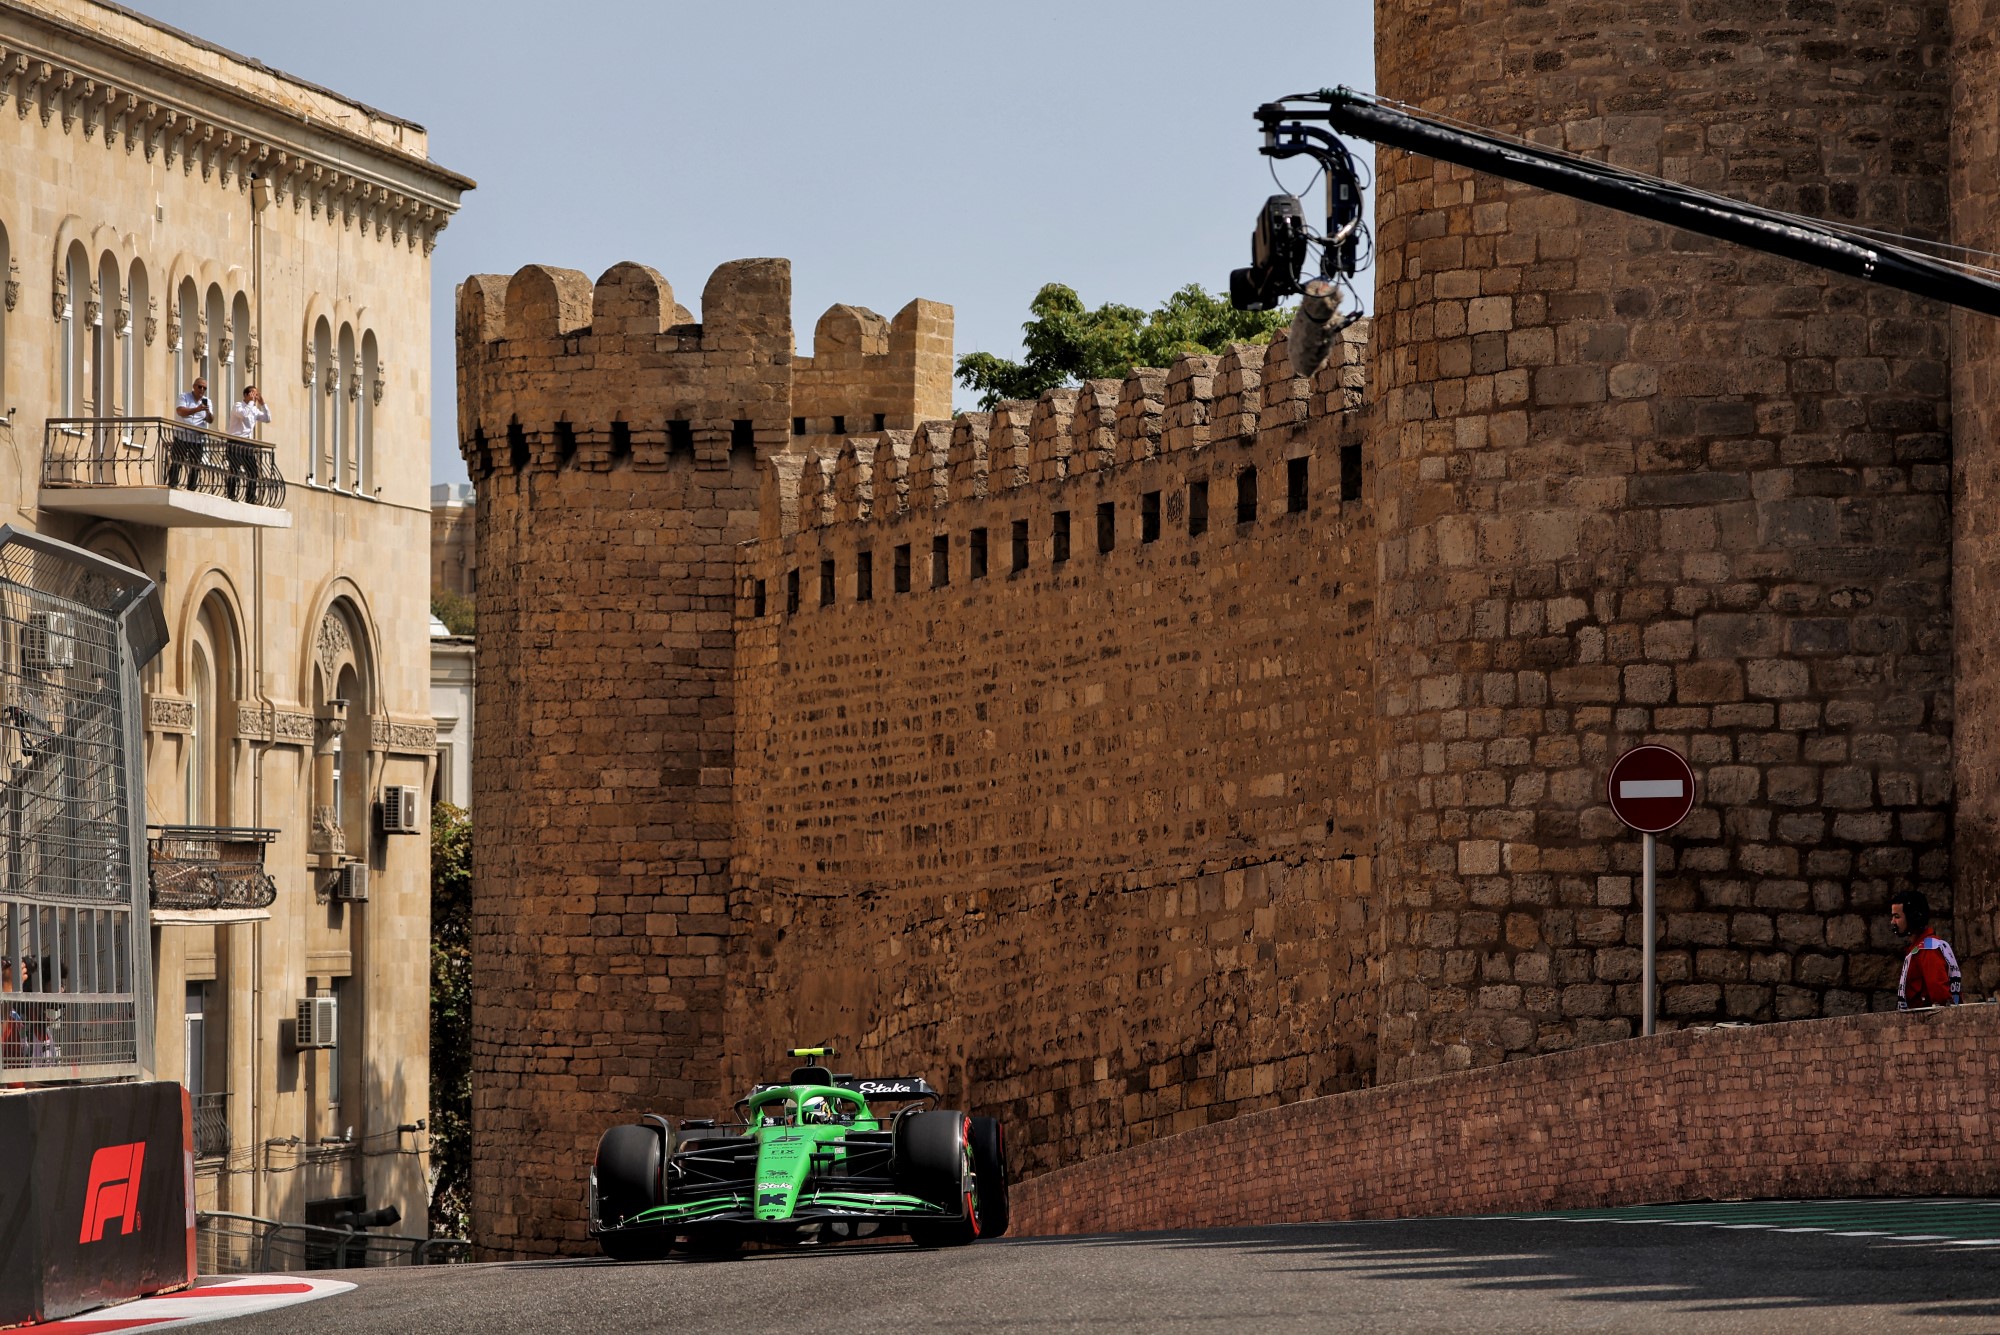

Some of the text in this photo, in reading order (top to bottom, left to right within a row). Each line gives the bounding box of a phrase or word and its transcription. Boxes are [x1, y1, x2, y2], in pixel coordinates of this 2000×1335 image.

[859, 1081, 911, 1094] Stake
[79, 1141, 146, 1244] F1
[757, 1182, 793, 1191] Stake
